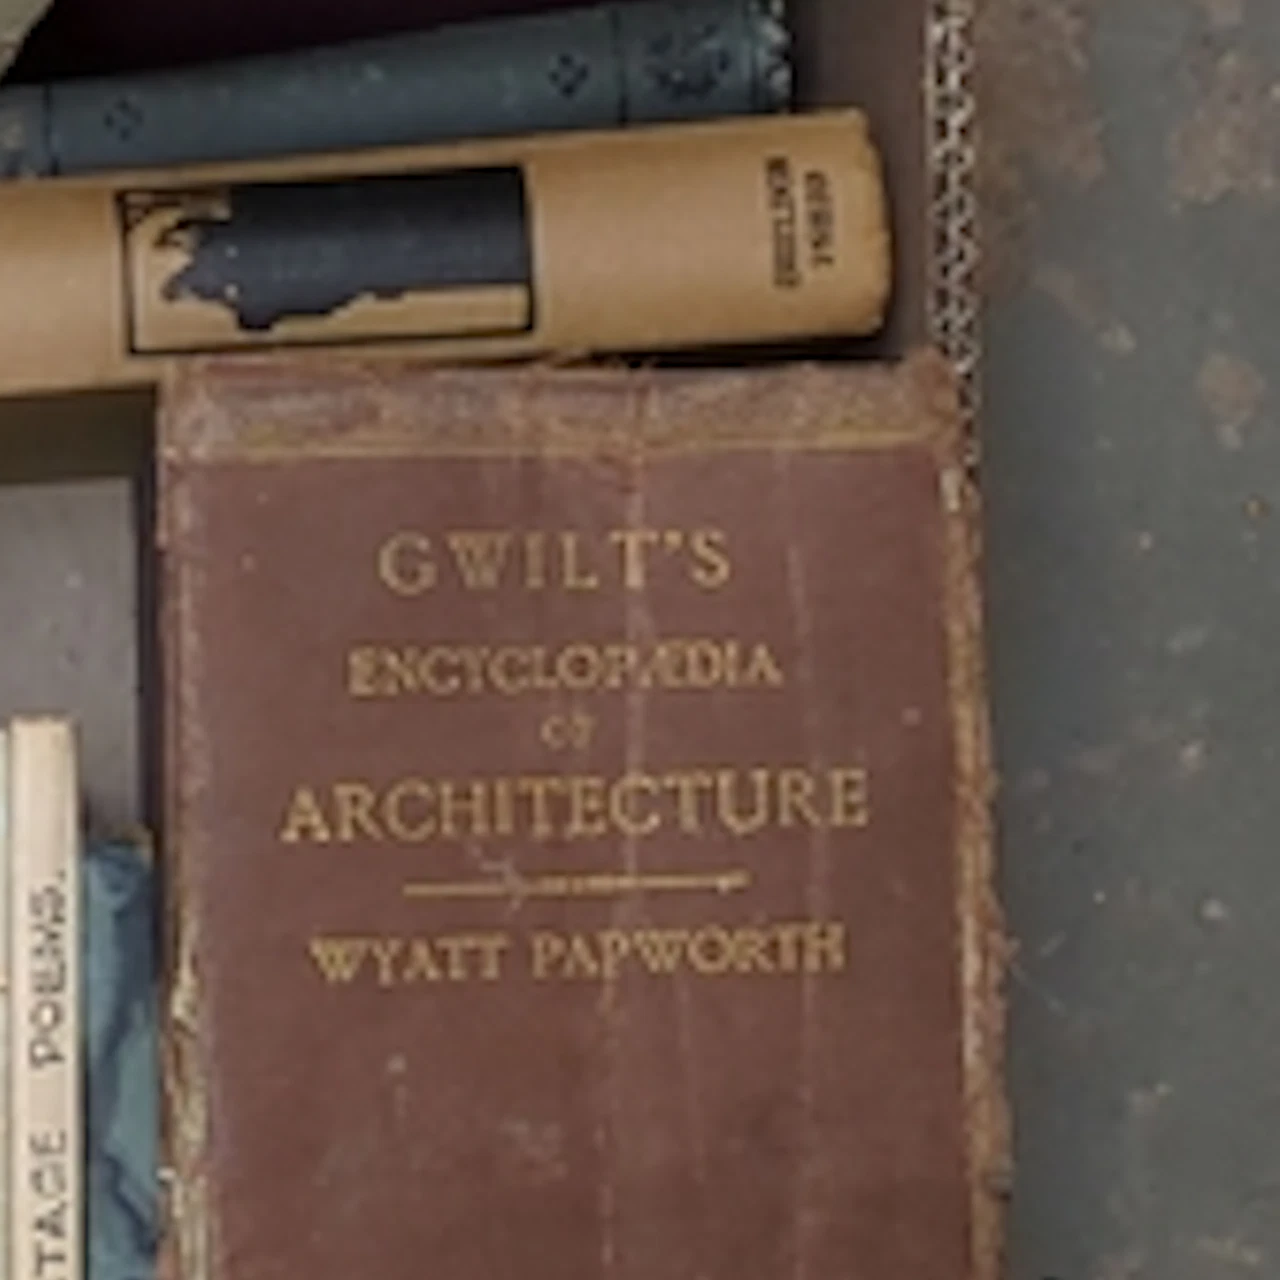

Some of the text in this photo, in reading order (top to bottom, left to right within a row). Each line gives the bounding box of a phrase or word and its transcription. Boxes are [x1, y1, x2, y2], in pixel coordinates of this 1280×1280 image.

[377, 526, 733, 596] GWILT'S
[280, 767, 870, 843] ARCHITECTURE
[30, 868, 68, 1070] POEMS.
[309, 921, 845, 987] WYATT PAPWORTH
